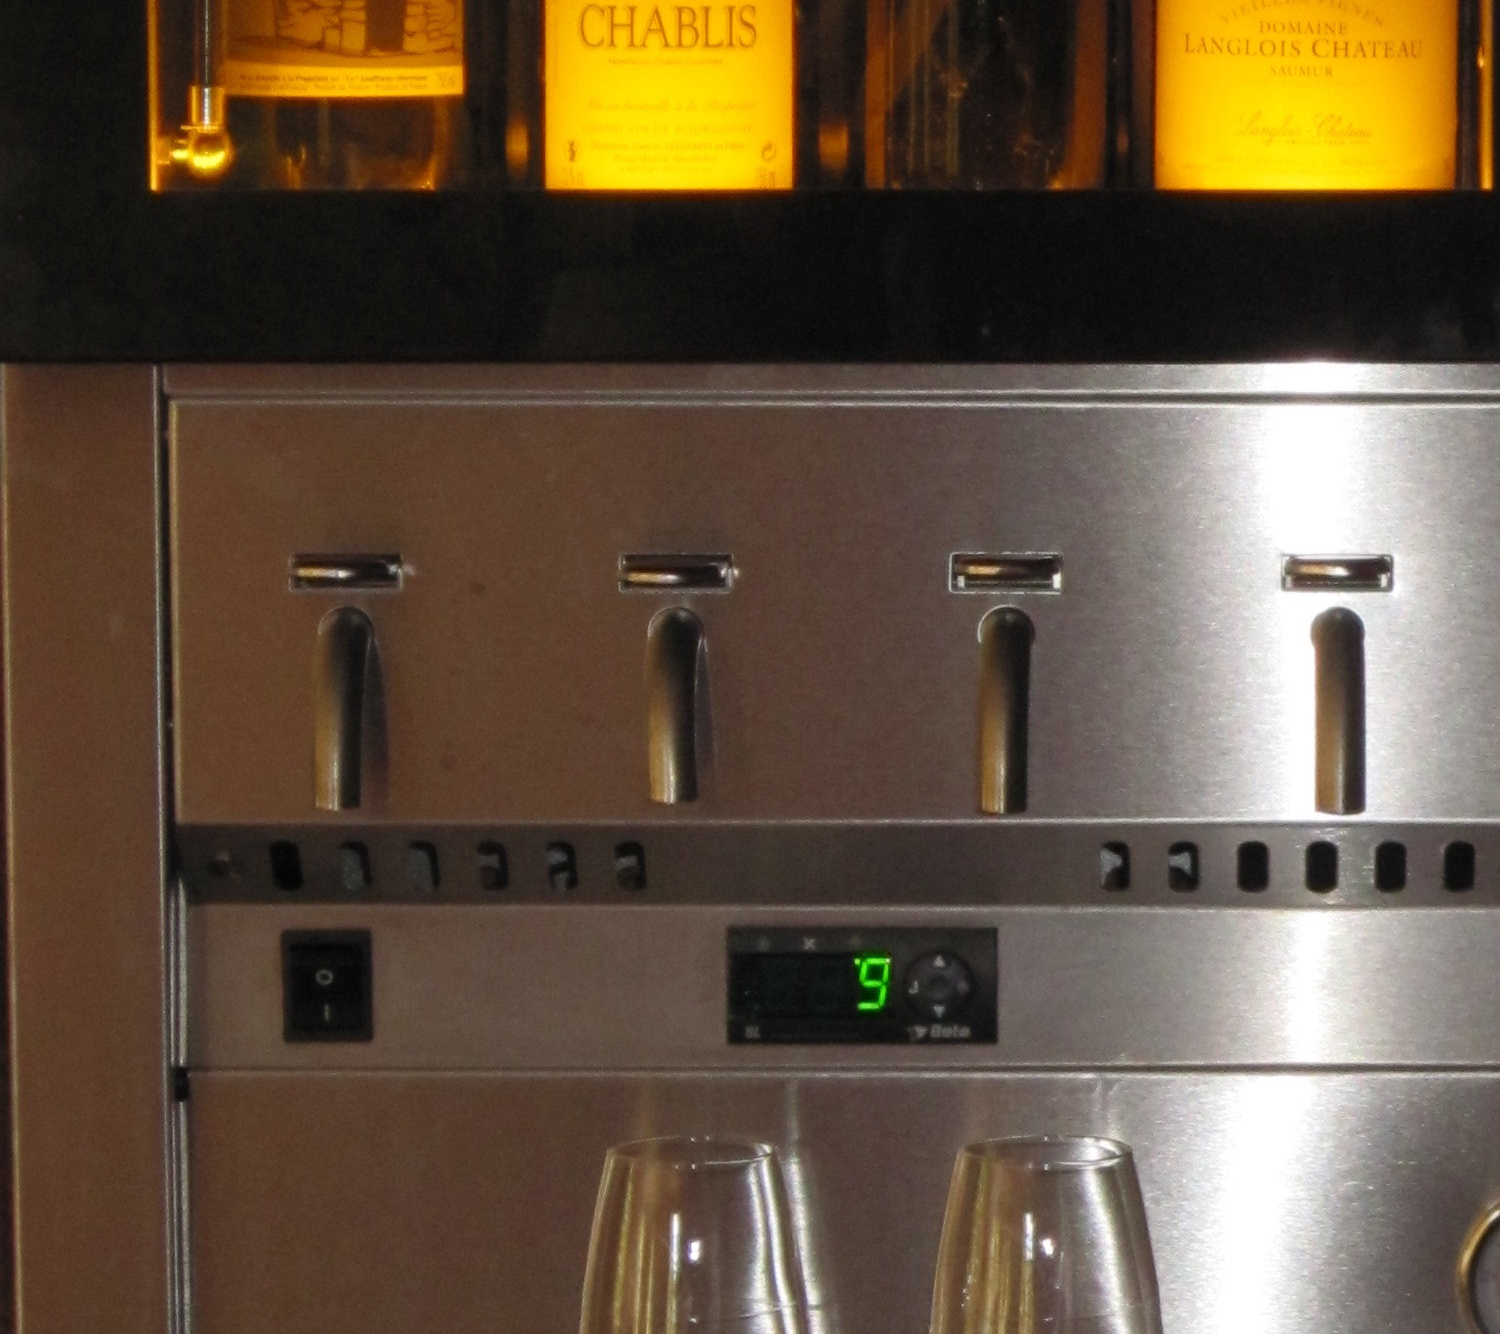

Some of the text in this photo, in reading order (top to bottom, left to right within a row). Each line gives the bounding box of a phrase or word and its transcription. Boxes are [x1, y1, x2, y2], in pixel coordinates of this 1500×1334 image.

[579, 3, 758, 51] CHABLIS
[1258, 20, 1348, 36] DOMAINE
[1184, 32, 1424, 60] LANGLOIS CHATEAU
[1269, 65, 1335, 78] SAUMUR
[857, 956, 891, 1010] 9
